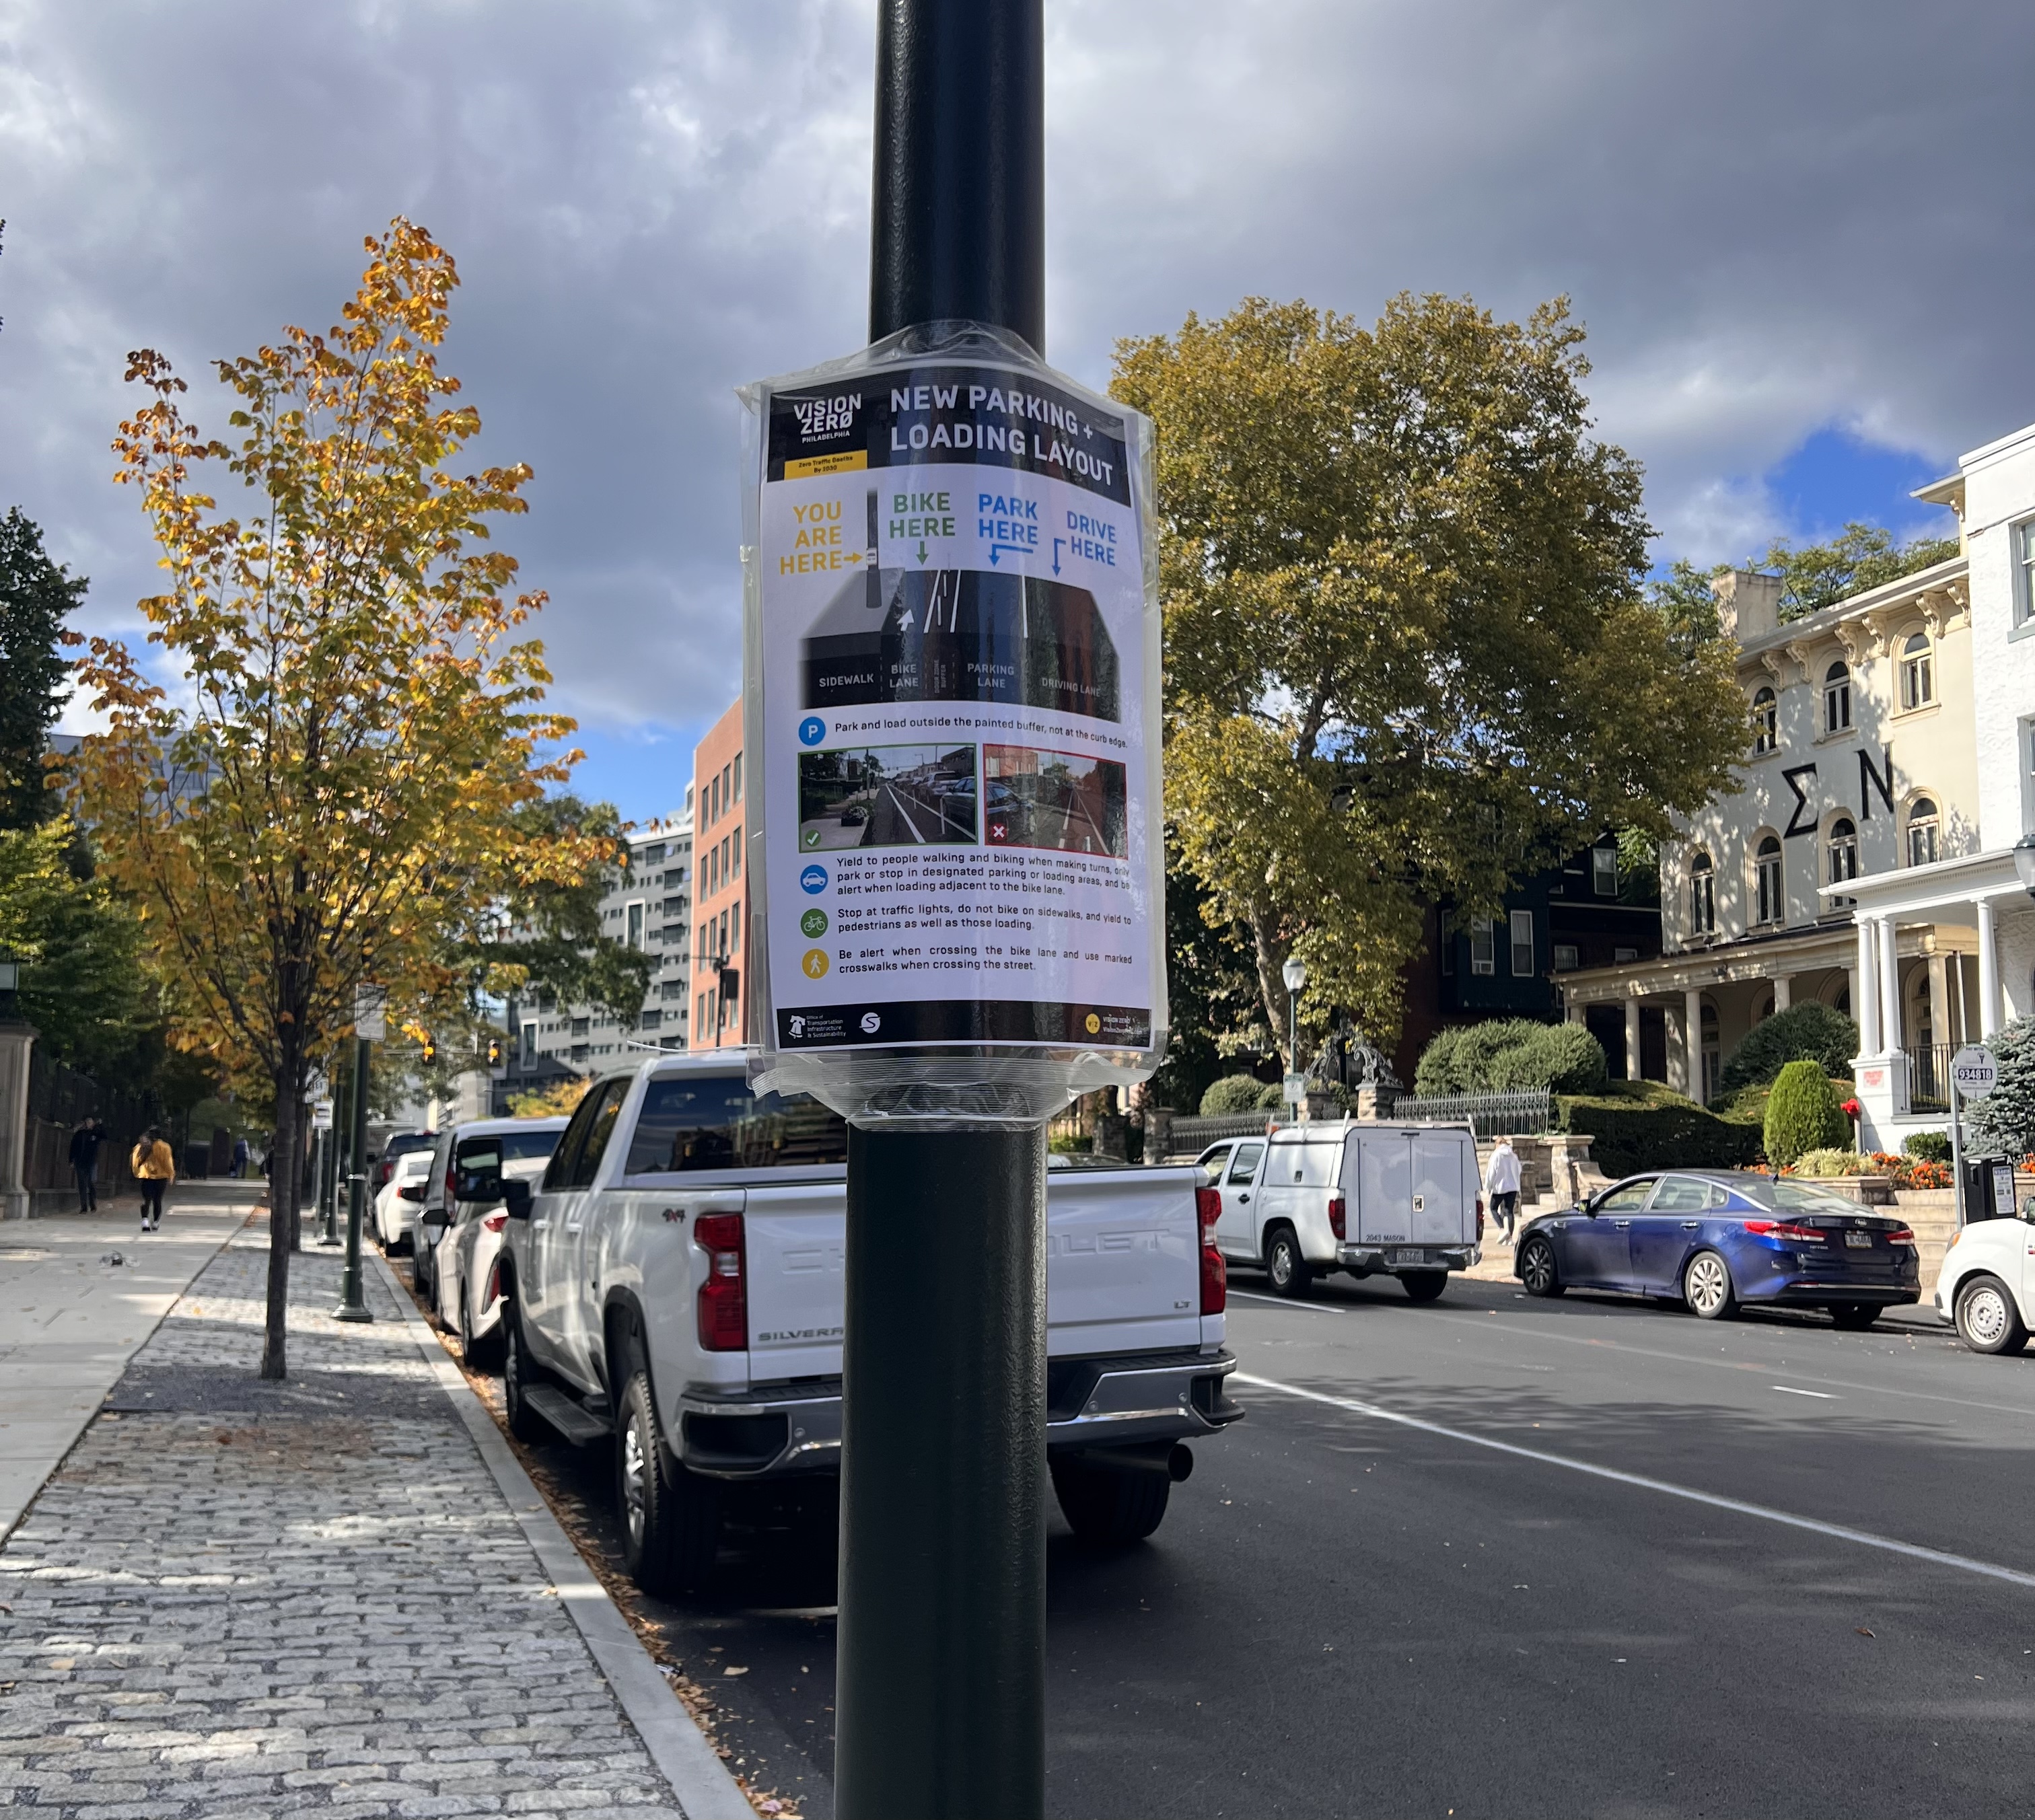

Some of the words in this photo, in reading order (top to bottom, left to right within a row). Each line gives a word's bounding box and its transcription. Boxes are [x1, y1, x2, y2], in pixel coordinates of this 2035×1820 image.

[793, 393, 861, 420] VISION
[891, 385, 958, 413] NEW
[969, 386, 1079, 437] PARKING
[801, 430, 850, 444] PHILADELPHIA
[813, 459, 831, 467] Traffic
[891, 423, 1026, 456] LOADING
[1034, 434, 1114, 486] LAYOUT
[793, 501, 842, 524] YOU
[894, 492, 951, 514] BIKE
[978, 493, 1038, 521] PARK
[795, 525, 843, 549] ARE
[889, 517, 956, 539] HERE
[978, 519, 1039, 546] HERE
[1067, 510, 1117, 544] DRIVE
[1071, 536, 1116, 567] HERE
[780, 550, 843, 575] HERE
[891, 664, 917, 675] BIKE
[967, 663, 1015, 676] PARKING
[819, 673, 874, 688] SIDEWALK
[889, 678, 919, 688] LANE
[977, 677, 1007, 688] LANE
[1042, 677, 1078, 693] DRIVING
[1080, 686, 1101, 698] LANE
[835, 721, 858, 733] Park
[861, 719, 880, 730] and
[884, 718, 906, 729] load
[910, 717, 951, 727] outside
[954, 717, 972, 727] the
[975, 718, 1013, 729] painted
[1017, 720, 1046, 734] buffer,
[1049, 726, 1063, 736] not
[1065, 728, 1074, 737] at
[1076, 729, 1089, 740] the
[1090, 733, 1107, 743] curb
[1109, 735, 1128, 749] edge.
[836, 856, 863, 867] Yield
[867, 857, 878, 865] to
[882, 854, 919, 866] people
[923, 852, 965, 864] walking
[969, 853, 989, 863] and
[994, 853, 1025, 866] biking
[1028, 857, 1052, 867] when
[1056, 859, 1087, 872] making
[1089, 863, 1112, 875] turns,
[1114, 866, 1130, 877] only
[837, 871, 861, 883] park
[865, 871, 875, 879] or
[879, 869, 903, 879] stop
[908, 867, 918, 877] in
[923, 867, 984, 879] designated
[989, 868, 1026, 880] parking
[1030, 871, 1040, 879] or
[1042, 871, 1075, 884] loading
[1078, 876, 1102, 887] areas,
[1105, 878, 1118, 889] and
[1120, 880, 1131, 890] be
[837, 885, 862, 895] alert
[865, 882, 892, 894] when
[896, 881, 935, 893] loading
[939, 881, 987, 893] adjacent
[989, 882, 1000, 891] to
[1003, 882, 1020, 892] the
[1022, 883, 1042, 894] bike
[1044, 885, 1065, 896] lane.
[838, 908, 862, 919] Stop
[866, 908, 877, 916] at
[881, 905, 915, 916] traffic
[919, 904, 954, 916] lights,
[958, 904, 971, 913] do
[976, 905, 993, 914] not
[997, 904, 1018, 915] bike
[1022, 907, 1034, 916] on
[1038, 906, 1083, 920] sidewalks,
[1086, 912, 1101, 922] and
[1103, 914, 1121, 925] yield
[1124, 916, 1131, 925] to
[838, 920, 901, 934] pedestrians
[904, 920, 917, 929] as
[921, 918, 942, 928] well
[945, 919, 958, 928] as
[962, 918, 992, 928] those
[995, 918, 1035, 931] loading.
[839, 949, 853, 959] Be
[860, 948, 885, 958] alert
[892, 946, 921, 956] when
[929, 945, 977, 957] crossing
[985, 945, 1003, 955] the
[1010, 945, 1031, 956] bike
[1038, 947, 1057, 957] lane
[1063, 950, 1079, 959] and
[1085, 952, 1099, 961] use
[1104, 953, 1133, 964] marked
[839, 961, 898, 974] crosswalks
[900, 959, 929, 970] when
[933, 959, 980, 971] crossing
[984, 960, 1001, 970] the
[1003, 961, 1036, 972] street.
[1959, 1068, 1992, 1081] 934818
[1173, 1299, 1192, 1309] LT
[758, 1326, 843, 1341] SILVERA
